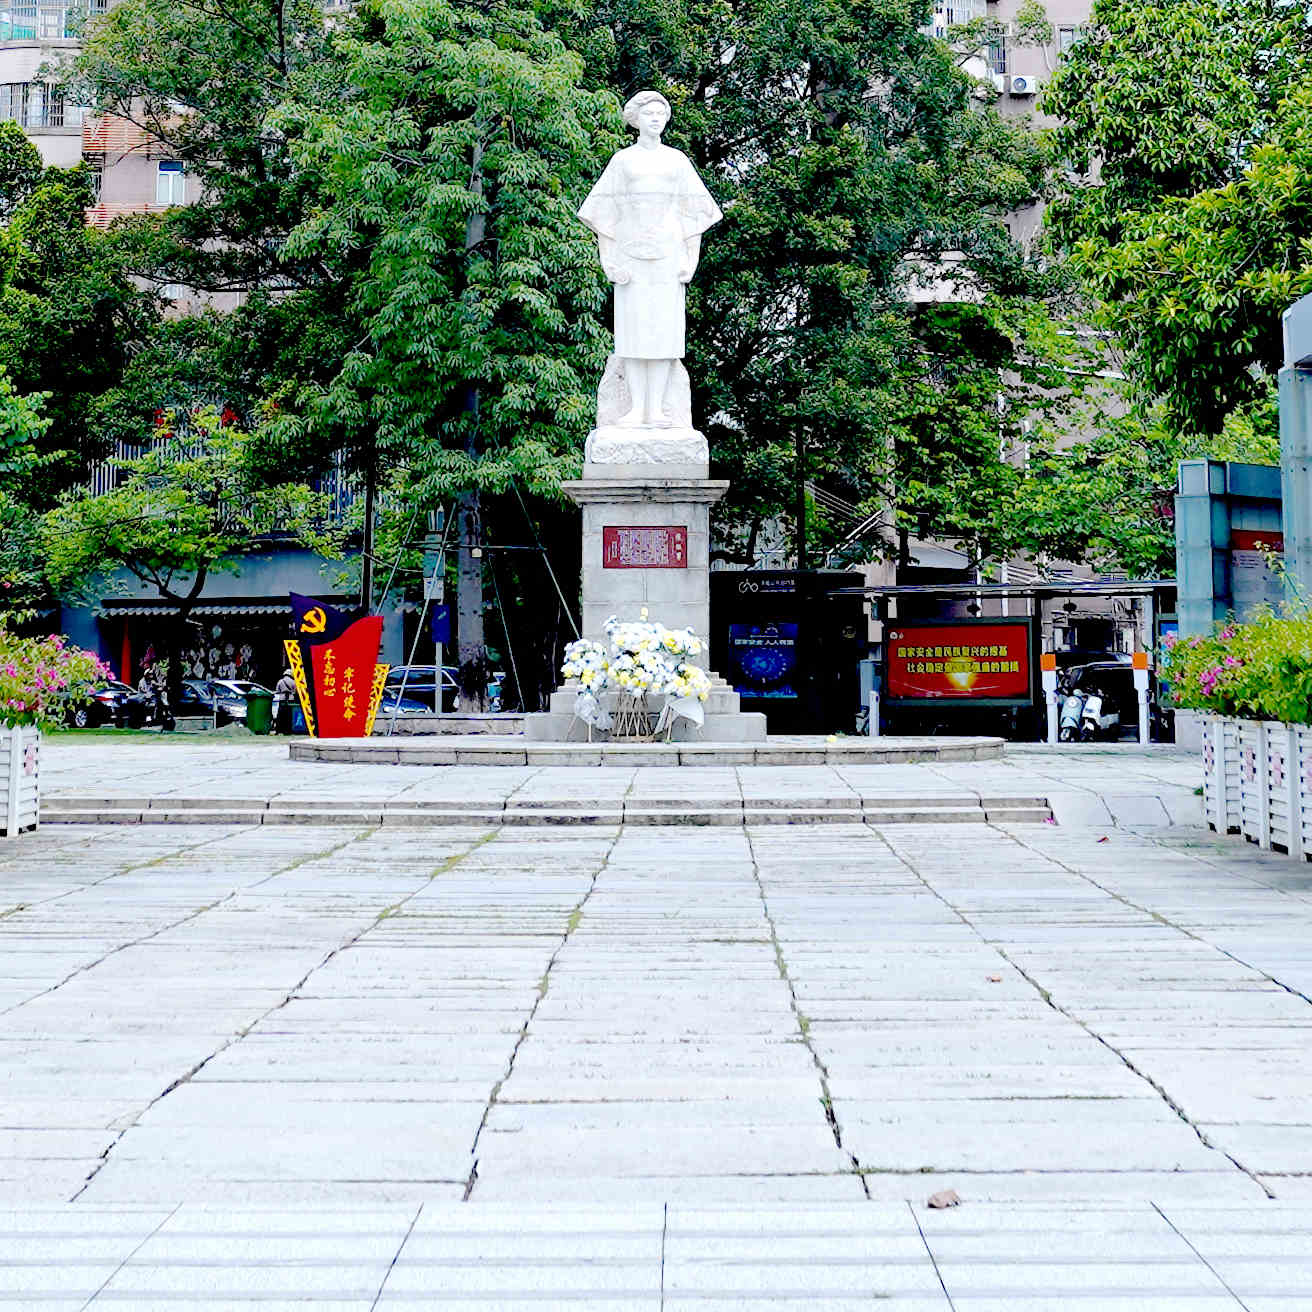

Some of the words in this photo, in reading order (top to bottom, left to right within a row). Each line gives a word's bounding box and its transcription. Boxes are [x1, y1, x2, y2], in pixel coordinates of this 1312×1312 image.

[323, 648, 337, 697] 不忘初心
[342, 666, 357, 722] 牢记使命
